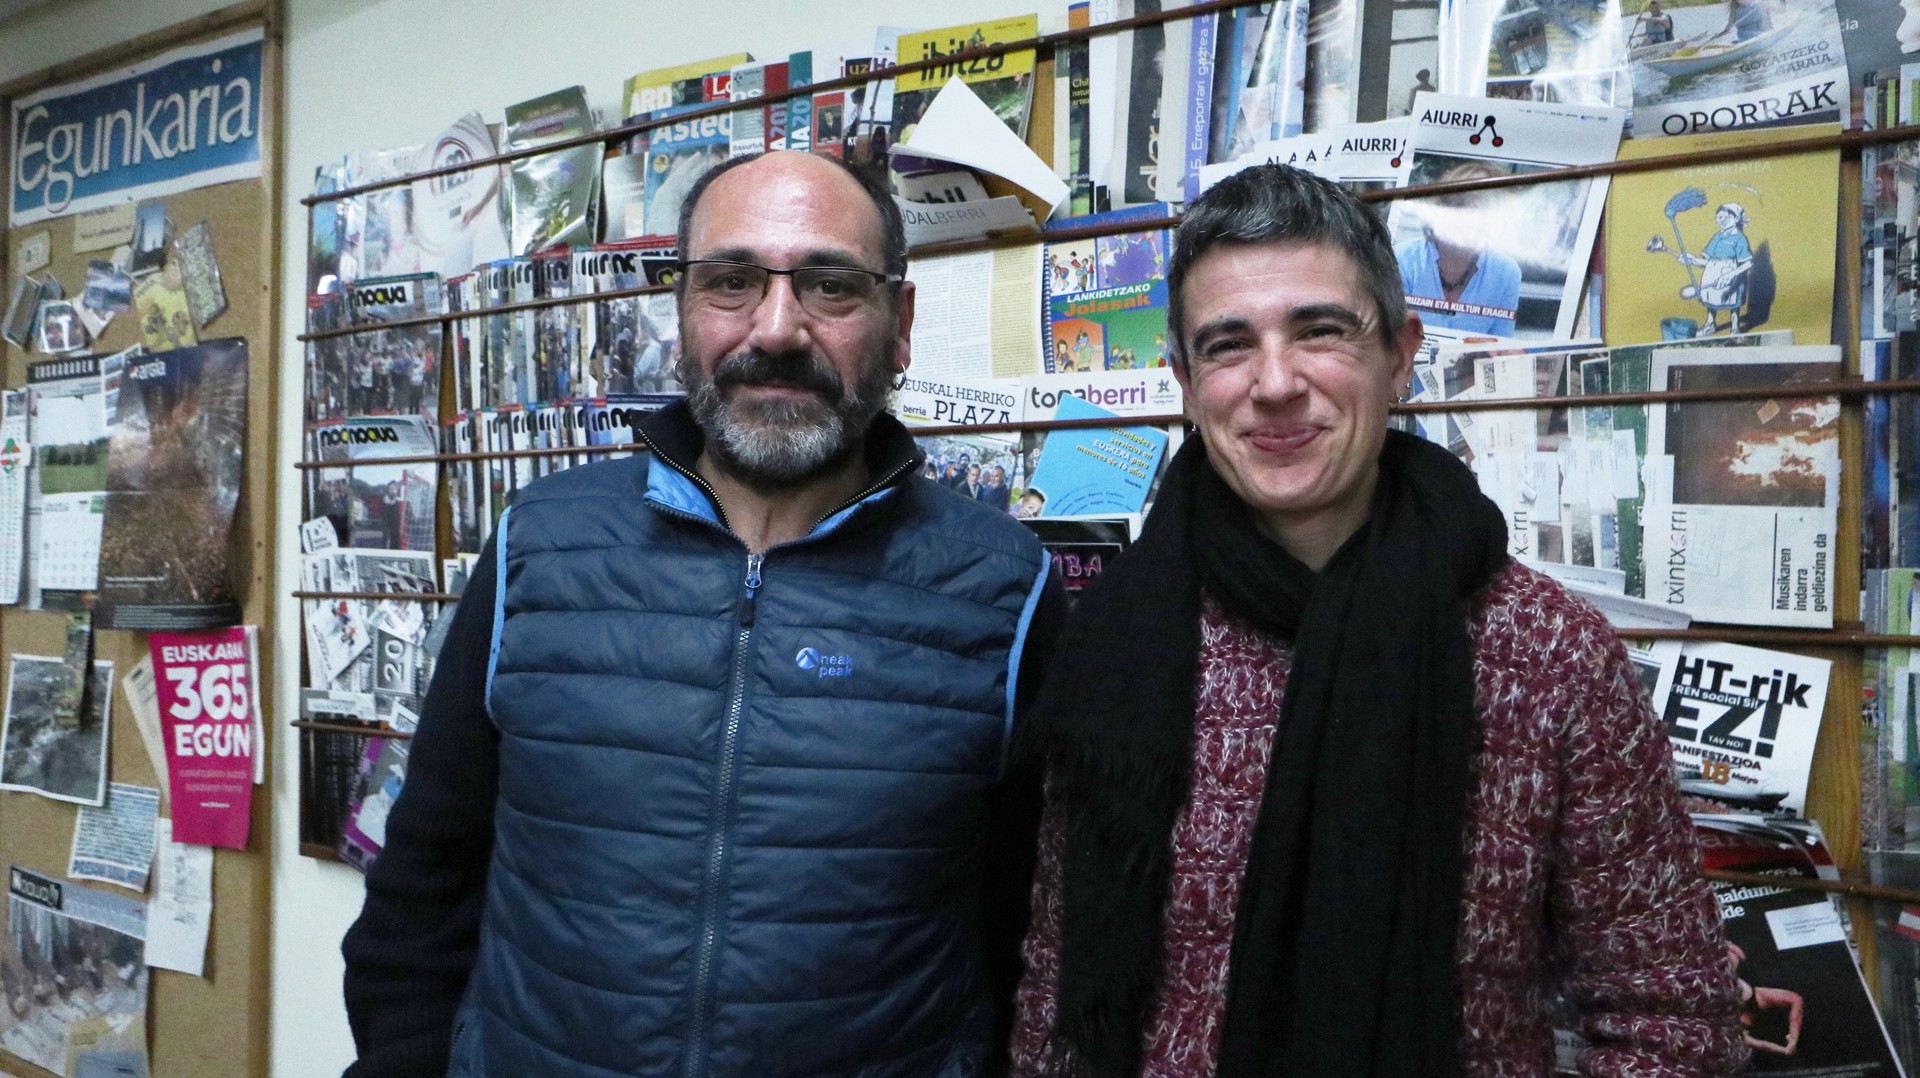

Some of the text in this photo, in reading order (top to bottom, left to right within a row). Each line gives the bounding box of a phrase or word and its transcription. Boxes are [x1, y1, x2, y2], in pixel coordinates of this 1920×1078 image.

[921, 38, 1005, 81] ihitza
[1420, 109, 1479, 128] AIURRI
[1661, 81, 1838, 135] OPORRAK
[17, 58, 254, 213] Egunkaria
[1341, 138, 1397, 152] AIURRI
[1064, 293, 1152, 317] Jolasak
[1067, 283, 1151, 303] LANKIDETZAKO
[1435, 300, 1450, 310] ETA
[1450, 302, 1480, 314] KULTUR
[1482, 306, 1515, 319] ERAGILE
[904, 379, 1016, 408] EUSKAL HERRIKO
[903, 404, 927, 416] berria
[1108, 427, 1151, 447] ctividades
[1110, 437, 1154, 461] servicios en
[1076, 445, 1107, 462] menores
[1093, 439, 1150, 470] EUSKERA para
[1776, 547, 1792, 611] Musikaren
[1812, 532, 1828, 613] geldiezina da
[1793, 567, 1809, 612] indarra
[820, 655, 853, 665] neak
[819, 666, 853, 679] peak
[165, 664, 249, 721] 365
[1701, 691, 1741, 706] social
[174, 723, 251, 758] EGUN
[1708, 735, 1725, 746] TAV
[1673, 743, 1762, 771] ANIFESTAZIOA
[1702, 758, 1732, 785] 18
[1731, 772, 1759, 785] Mayo
